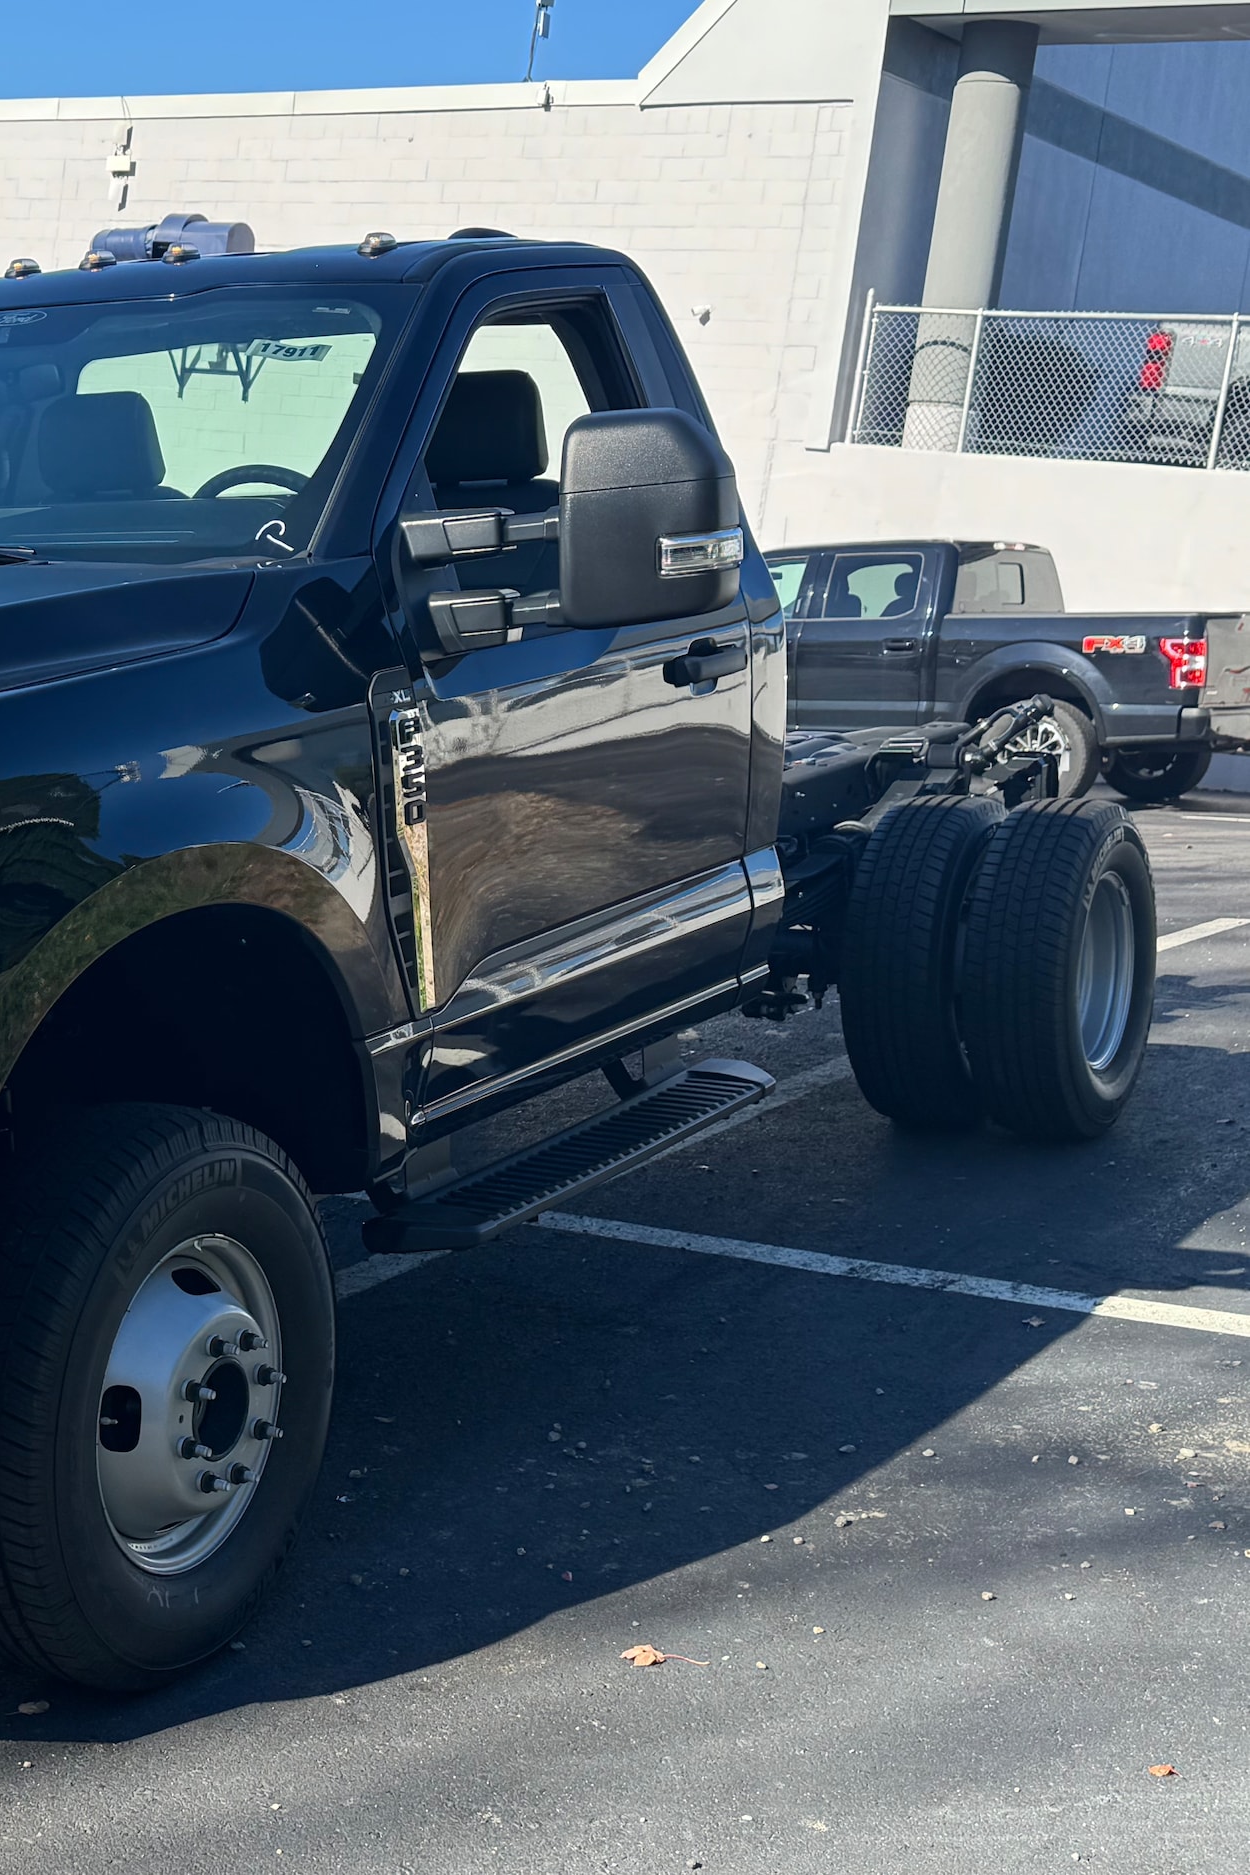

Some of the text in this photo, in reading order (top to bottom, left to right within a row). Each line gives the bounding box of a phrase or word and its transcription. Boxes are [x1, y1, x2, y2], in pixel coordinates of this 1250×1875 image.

[261, 342, 320, 357] 17911
[390, 689, 411, 703] XL
[141, 1158, 236, 1238] MICHELIN
